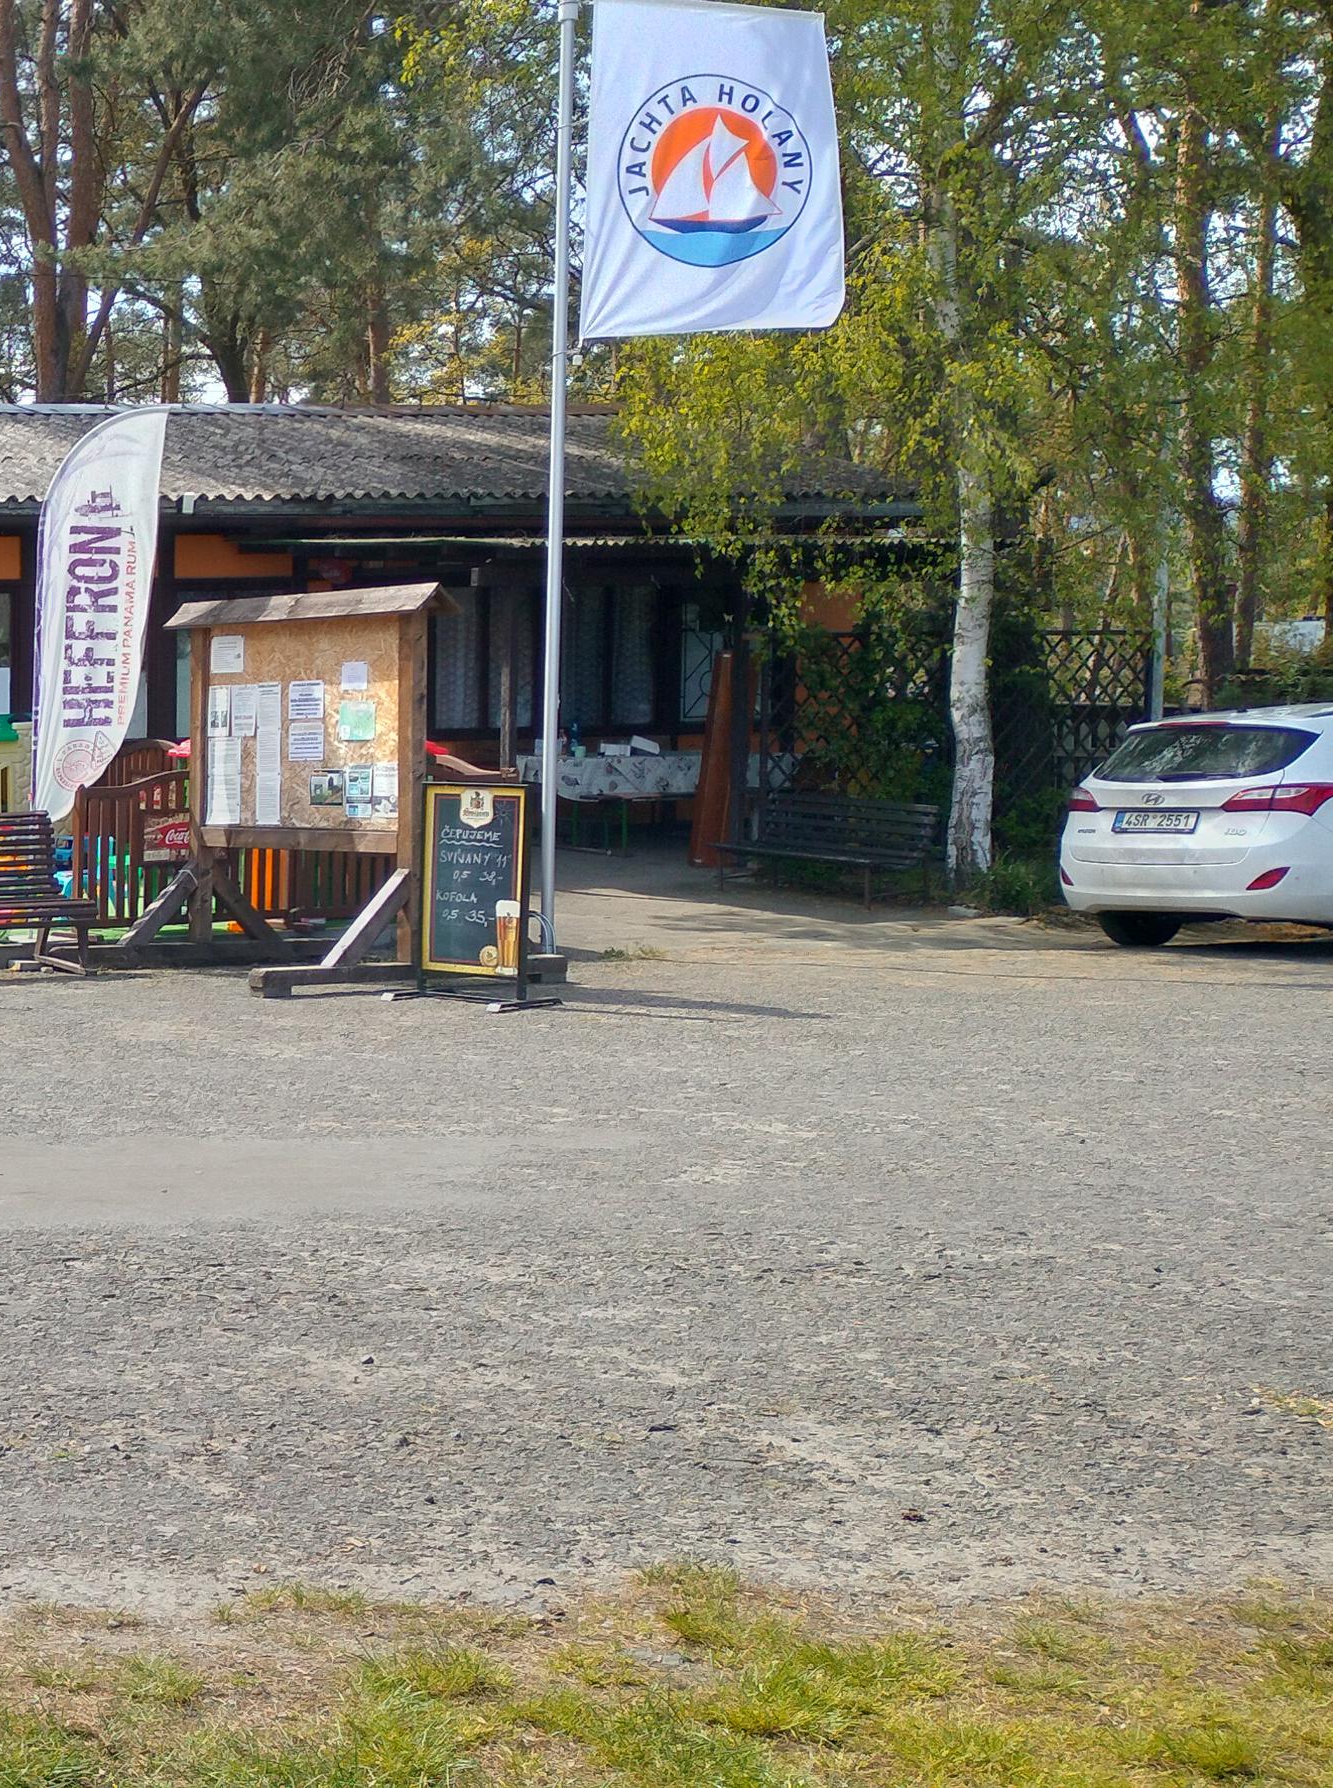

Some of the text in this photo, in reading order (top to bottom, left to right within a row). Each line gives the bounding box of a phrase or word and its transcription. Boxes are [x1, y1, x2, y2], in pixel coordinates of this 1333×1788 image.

[625, 82, 804, 199] JACHTA HOLANY
[62, 525, 122, 728] HEFFRON
[116, 540, 138, 727] PREMIUM PANAMA RUM
[1124, 814, 1190, 827] 4SR 2551
[441, 826, 502, 842] ČEPUJEME
[452, 870, 471, 882] 0,5
[436, 890, 478, 904] KOFOLA
[441, 909, 460, 920] 0,5
